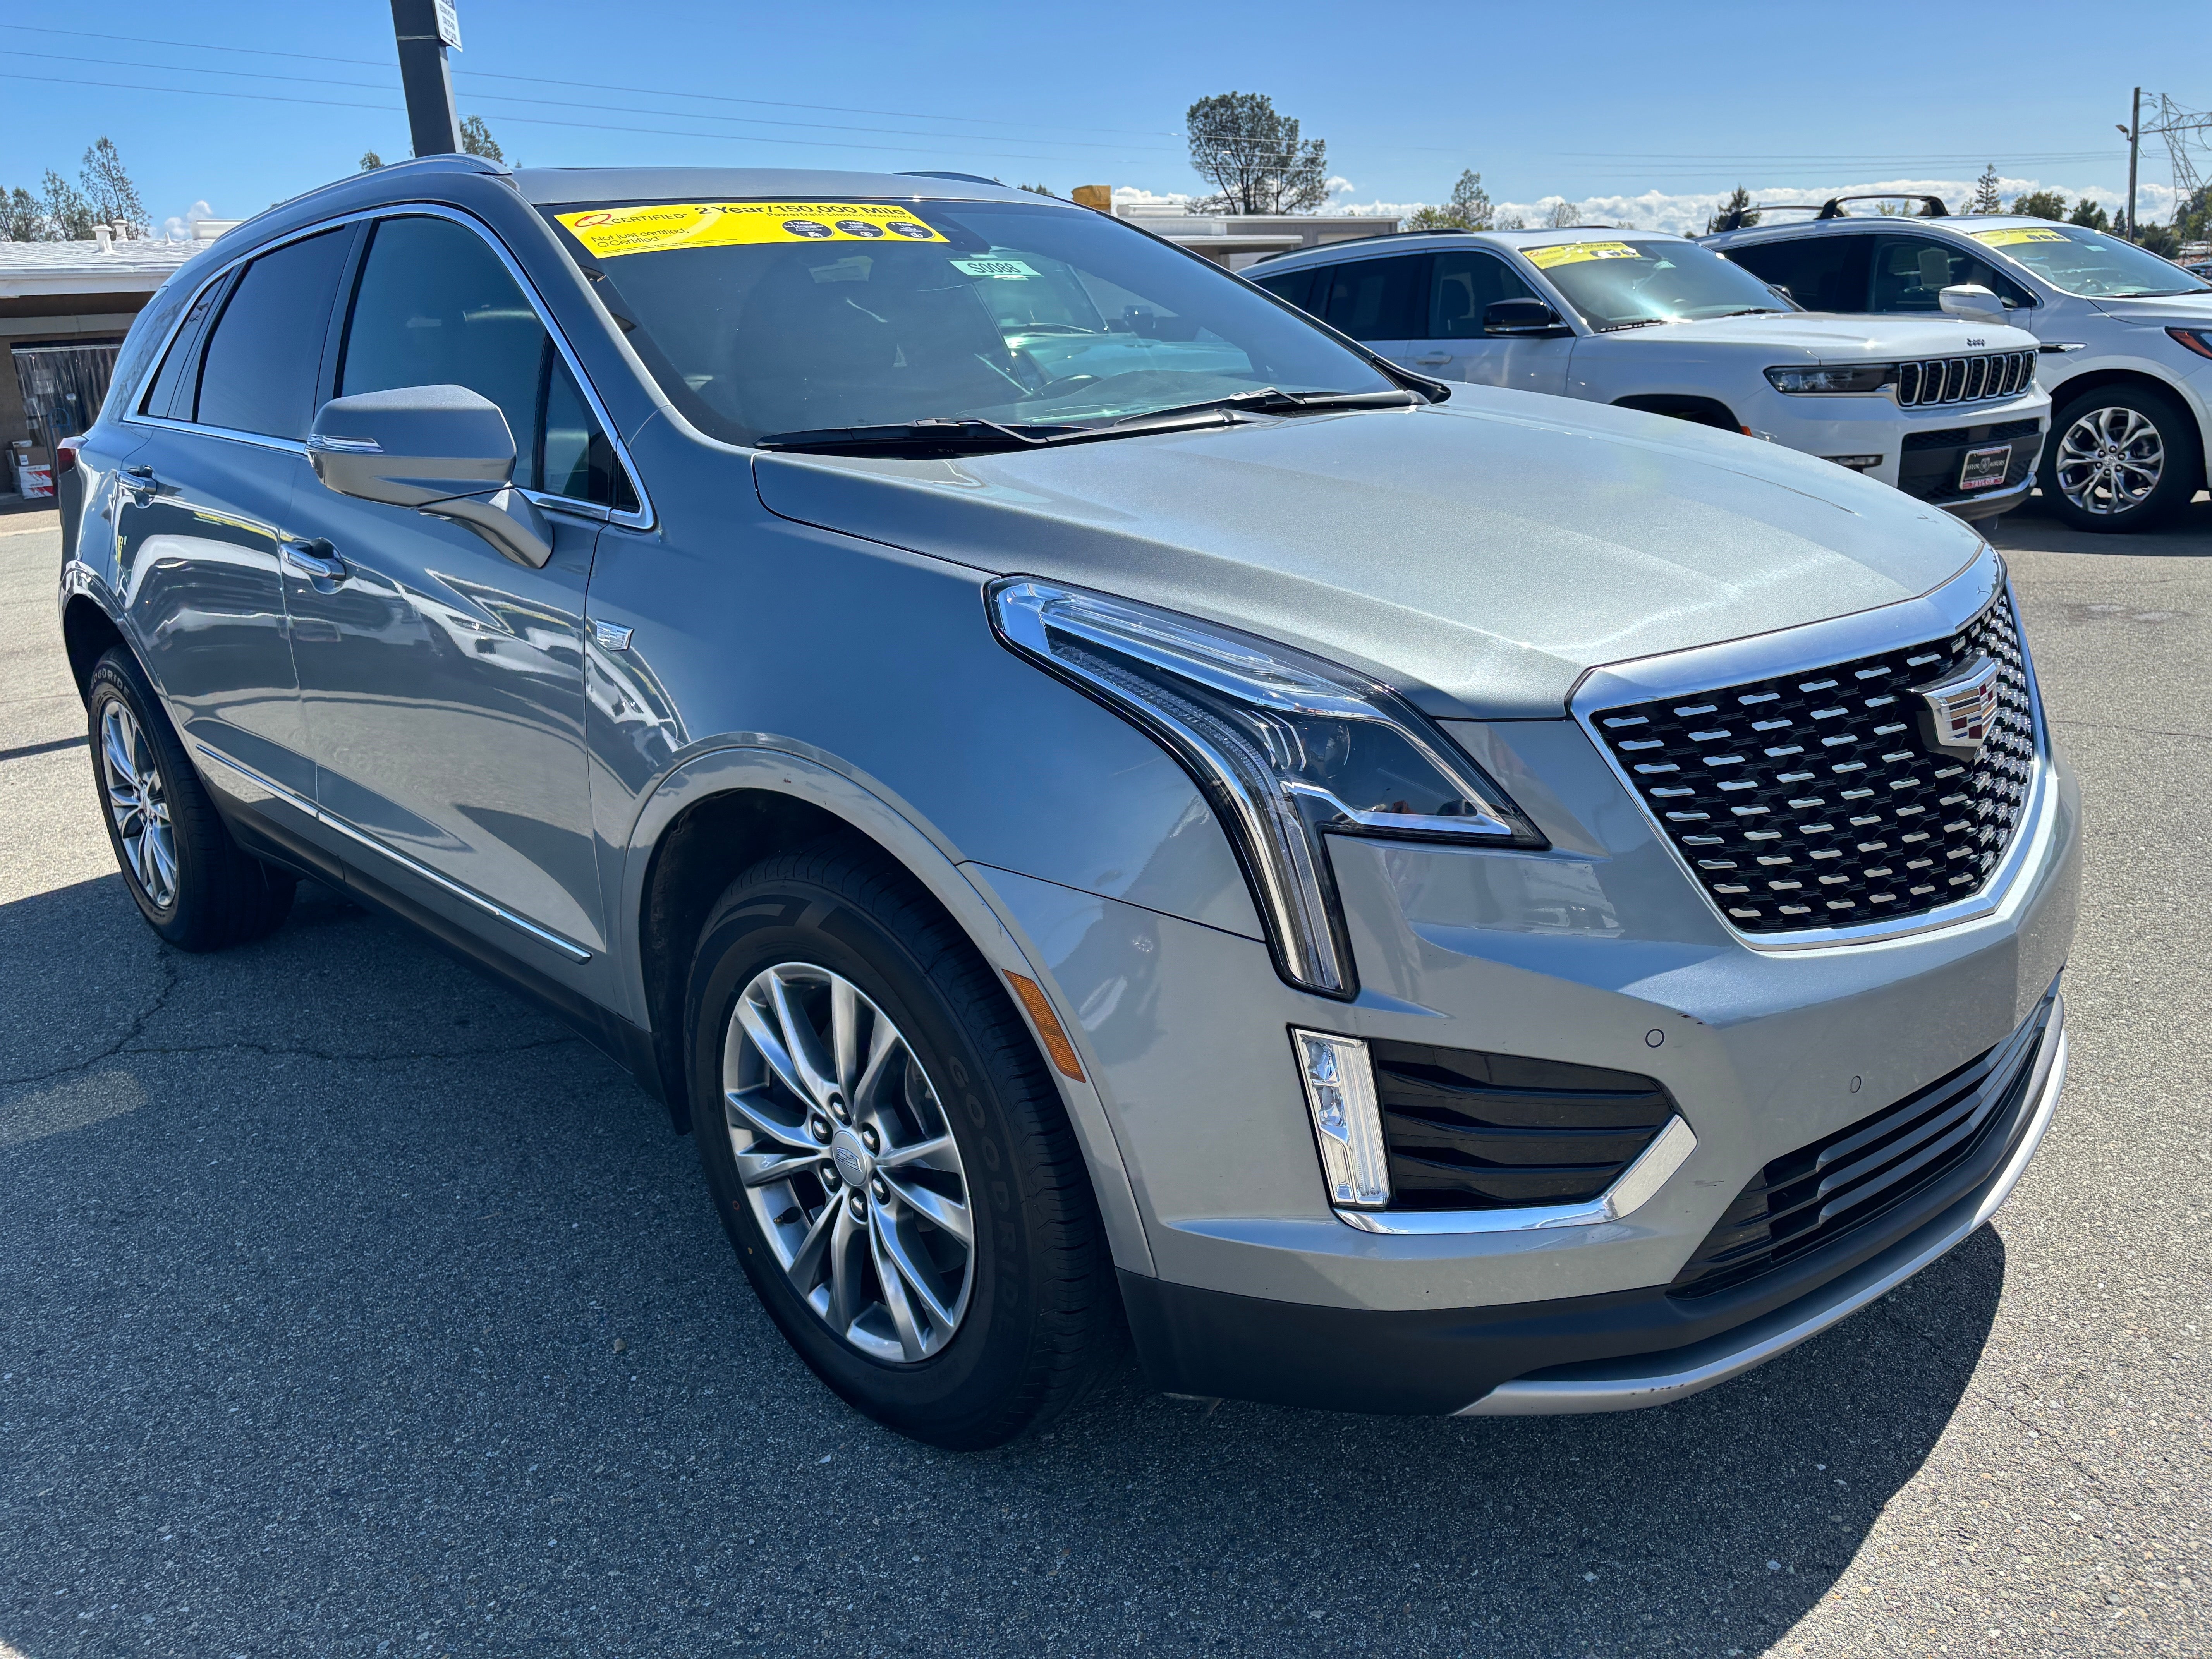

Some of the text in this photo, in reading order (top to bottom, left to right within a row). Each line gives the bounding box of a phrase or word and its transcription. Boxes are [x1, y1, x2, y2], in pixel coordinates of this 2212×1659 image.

[859, 206, 906, 215] Mile
[967, 263, 1021, 273] S0088
[948, 1055, 1019, 1339] GOODRIDE
